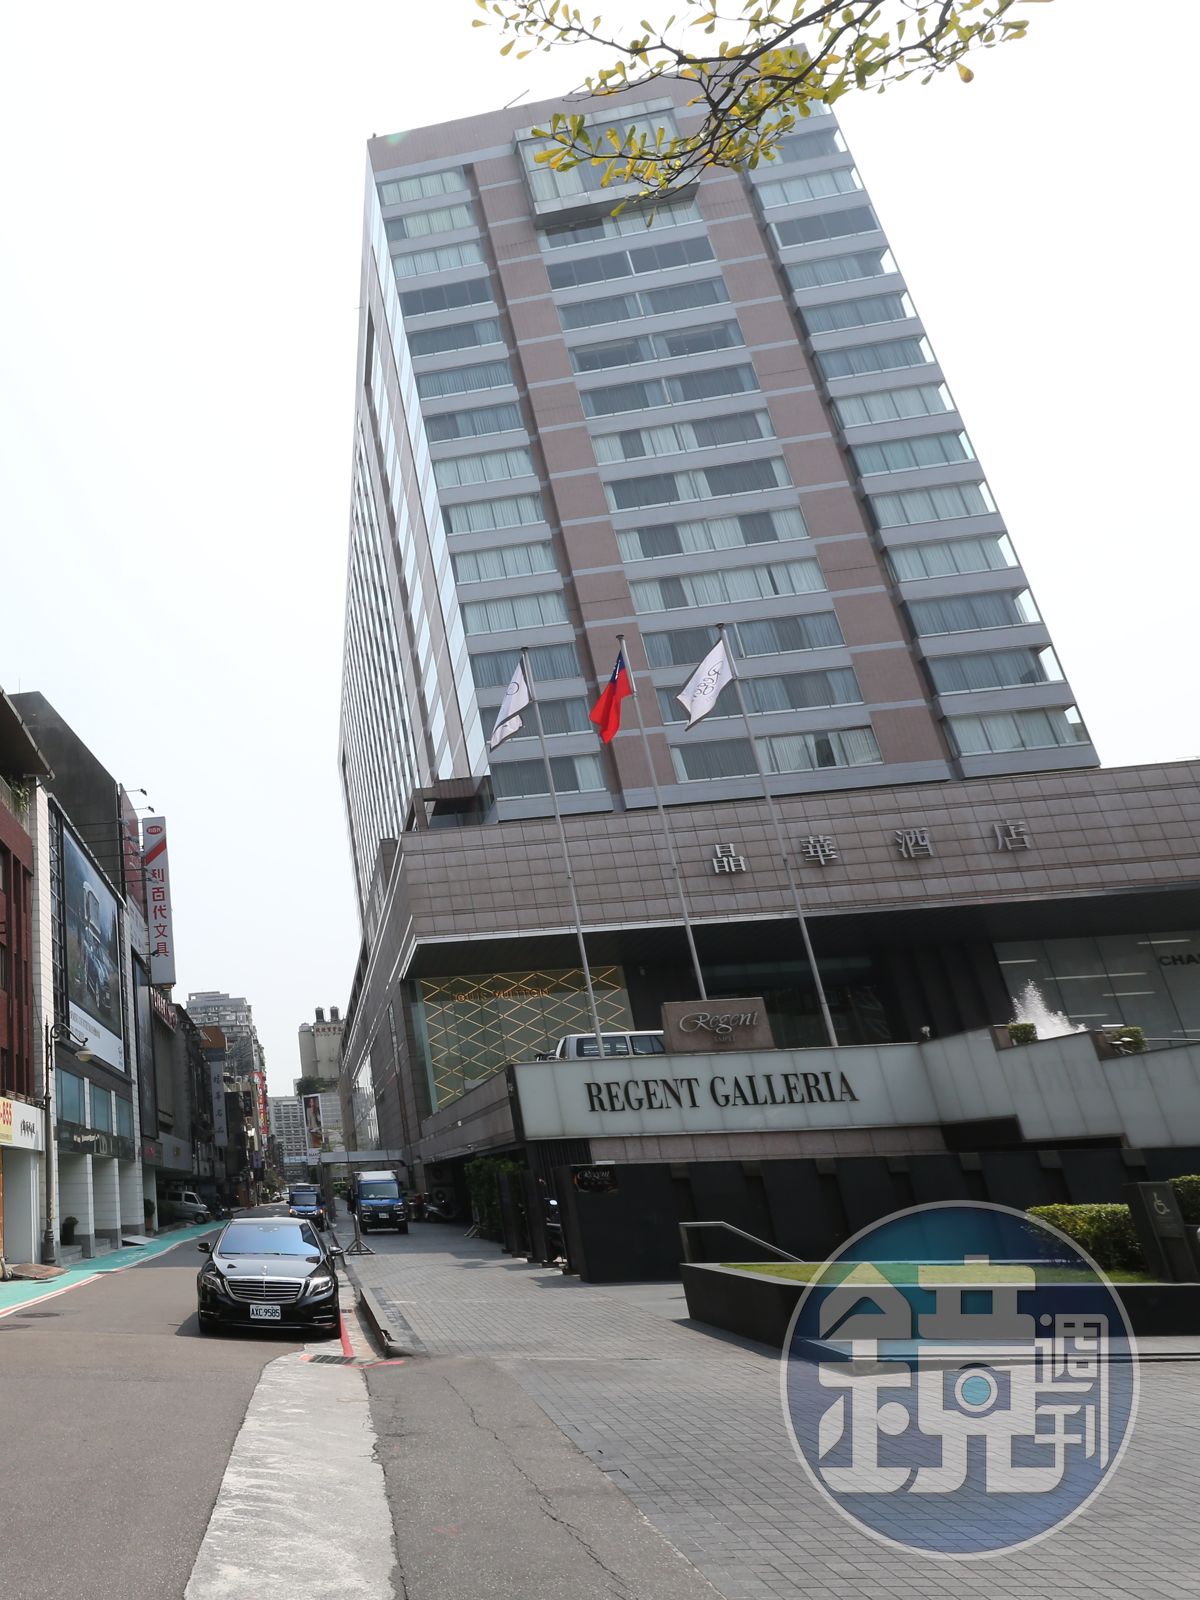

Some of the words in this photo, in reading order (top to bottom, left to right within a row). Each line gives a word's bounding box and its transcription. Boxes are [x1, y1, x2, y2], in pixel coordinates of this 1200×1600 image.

[712, 819, 1031, 873] 晶華酒店
[151, 867, 169, 957] 利百代文具
[1159, 954, 1200, 966] CHA
[680, 1010, 759, 1034] Regent
[584, 1077, 700, 1112] REGENT
[709, 1071, 860, 1107] GALLERIA
